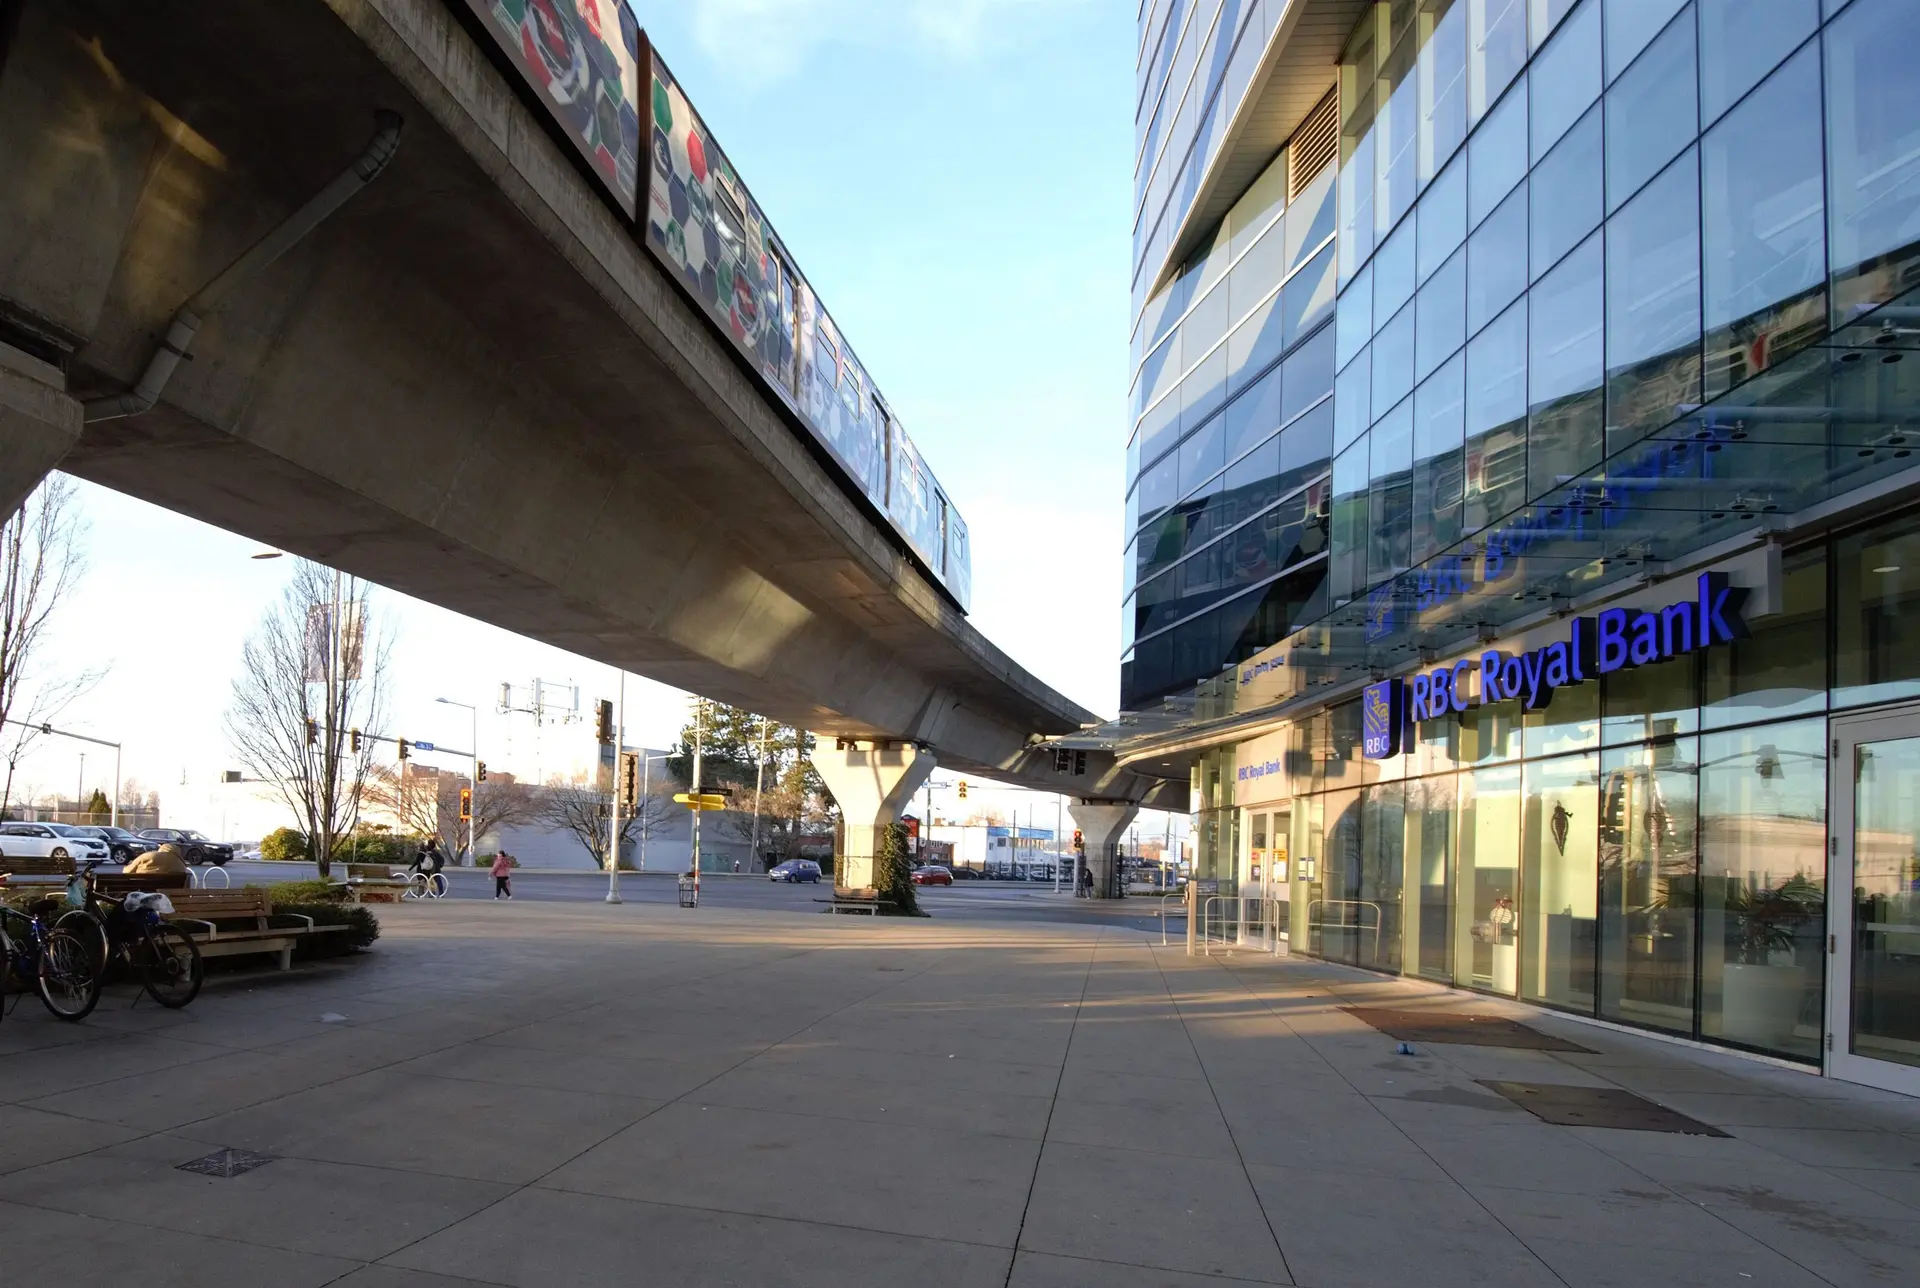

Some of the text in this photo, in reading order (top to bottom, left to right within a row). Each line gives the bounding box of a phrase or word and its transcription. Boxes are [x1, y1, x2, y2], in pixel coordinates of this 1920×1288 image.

[1412, 570, 1735, 723] RBC Royal Bank
[1366, 735, 1388, 754] RBC
[1238, 758, 1280, 780] RBC Royal Bank
